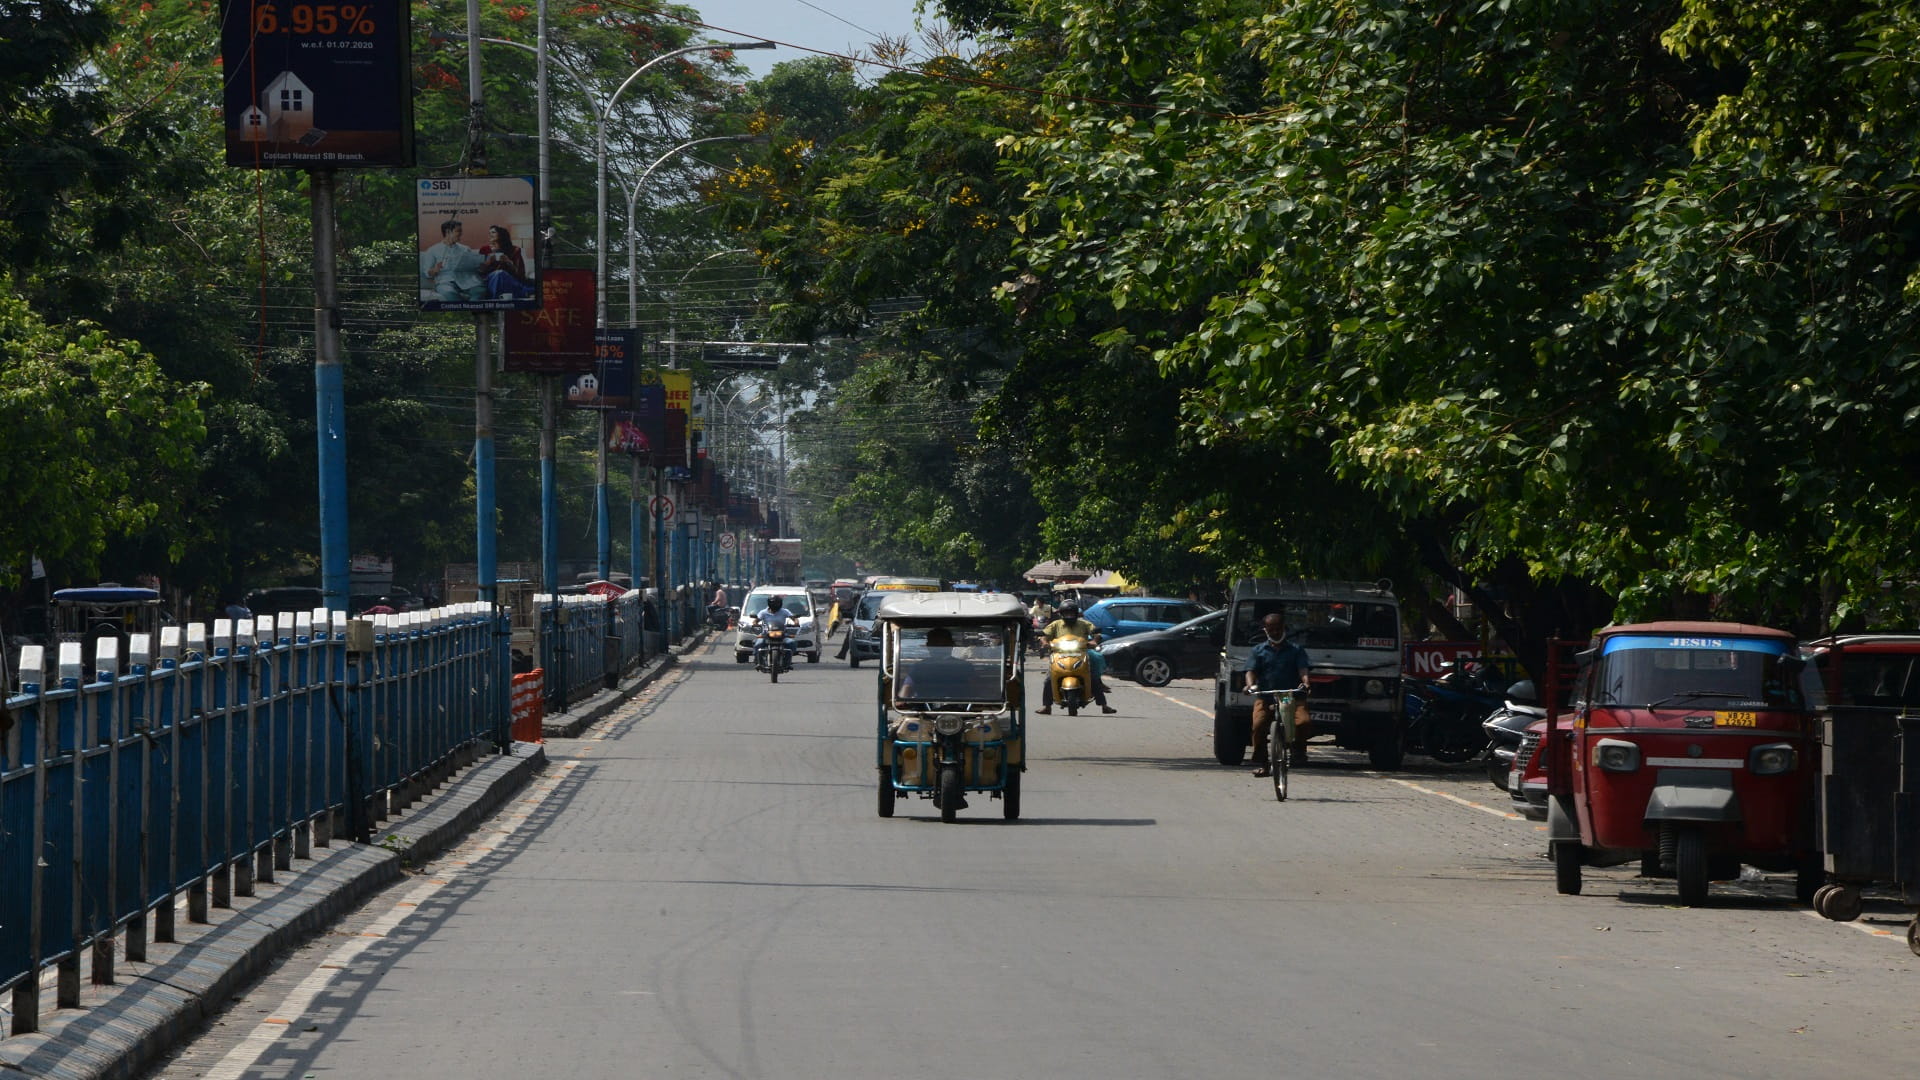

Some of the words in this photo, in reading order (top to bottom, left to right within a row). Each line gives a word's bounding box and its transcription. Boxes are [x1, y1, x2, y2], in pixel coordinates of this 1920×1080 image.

[326, 41, 374, 49] 01.07.2020
[263, 152, 291, 160] Contact
[292, 152, 321, 160] Nearest
[322, 152, 336, 160] SBI
[432, 180, 451, 190] SBI
[520, 307, 582, 328] SAFE
[1359, 638, 1393, 647] POLICE
[1669, 637, 1722, 648] JESUS
[1414, 650, 1444, 674] NO
